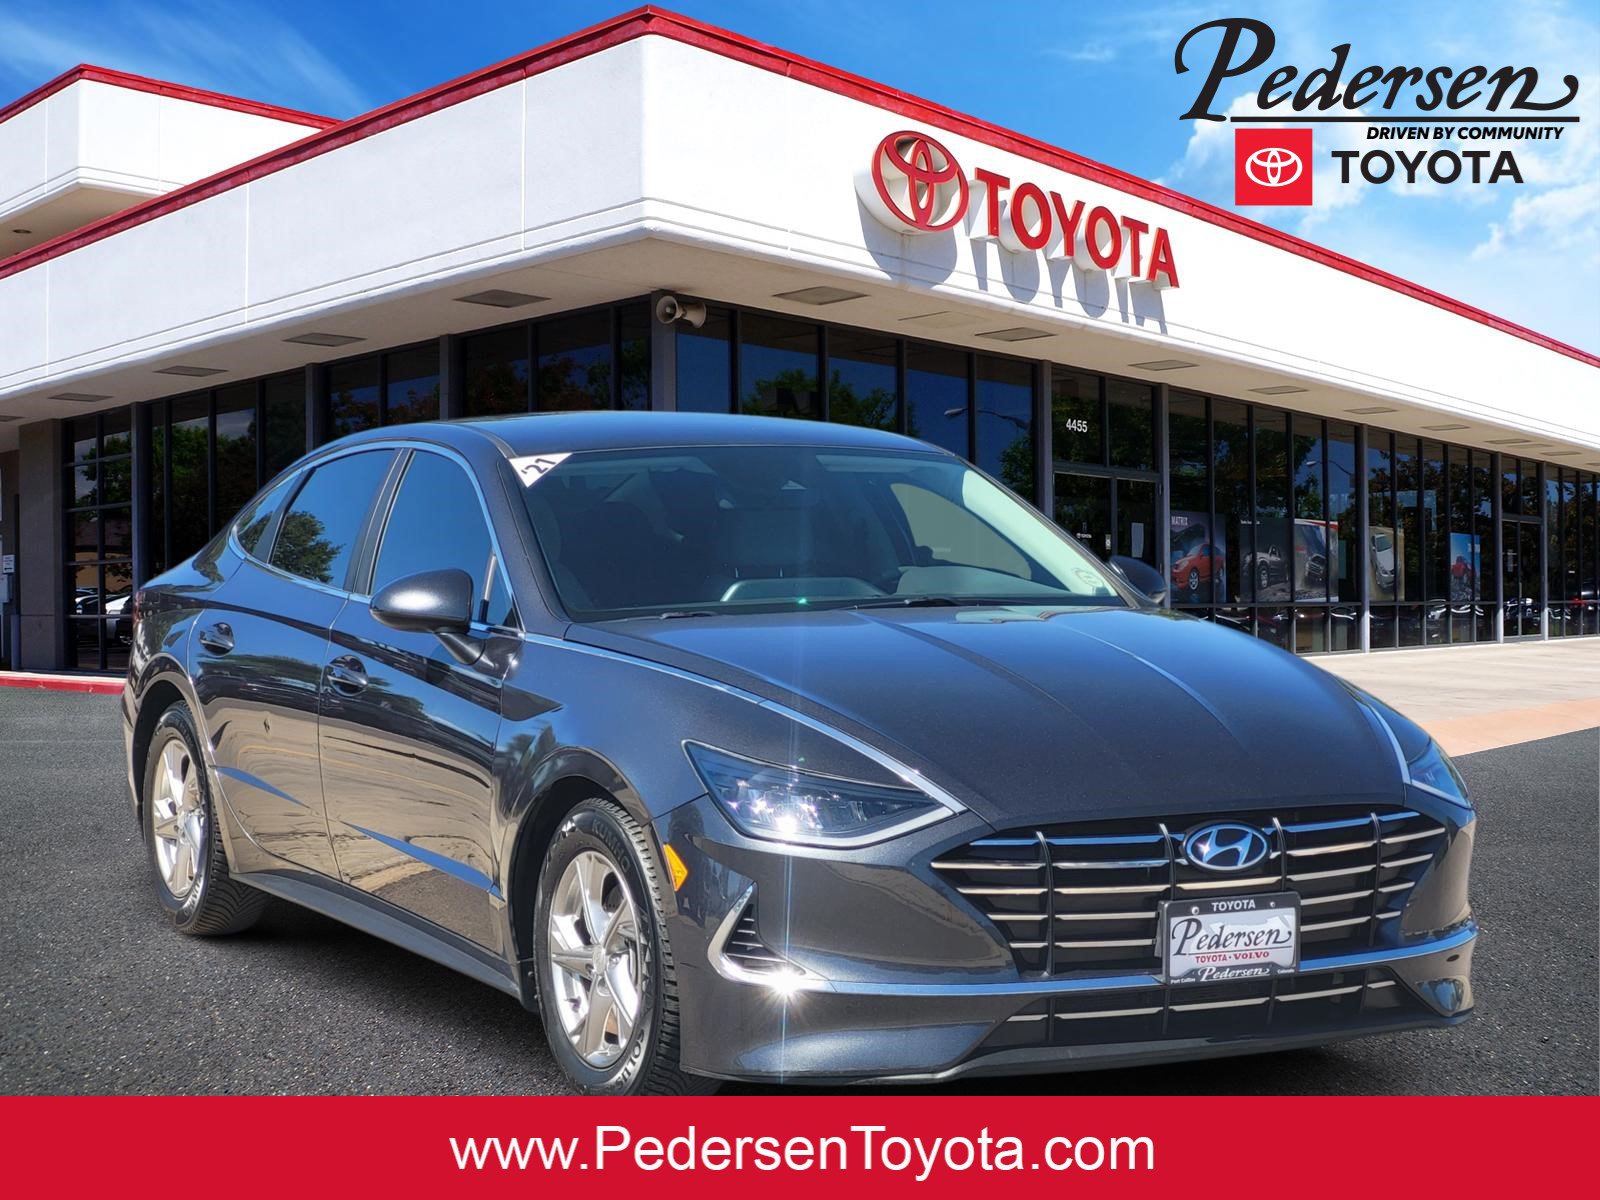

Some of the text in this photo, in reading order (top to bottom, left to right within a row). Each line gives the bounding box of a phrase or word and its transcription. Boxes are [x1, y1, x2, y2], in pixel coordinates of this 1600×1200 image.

[974, 167, 1180, 288] TOYOTA
[1065, 418, 1088, 433] 4455
[1211, 899, 1256, 912] TOYOTA
[1172, 918, 1292, 956] Pedersen
[1195, 951, 1269, 963] TOYOTA VOLVO
[1197, 966, 1270, 982] Pedersen
[614, 1028, 645, 1090] SOLUS
